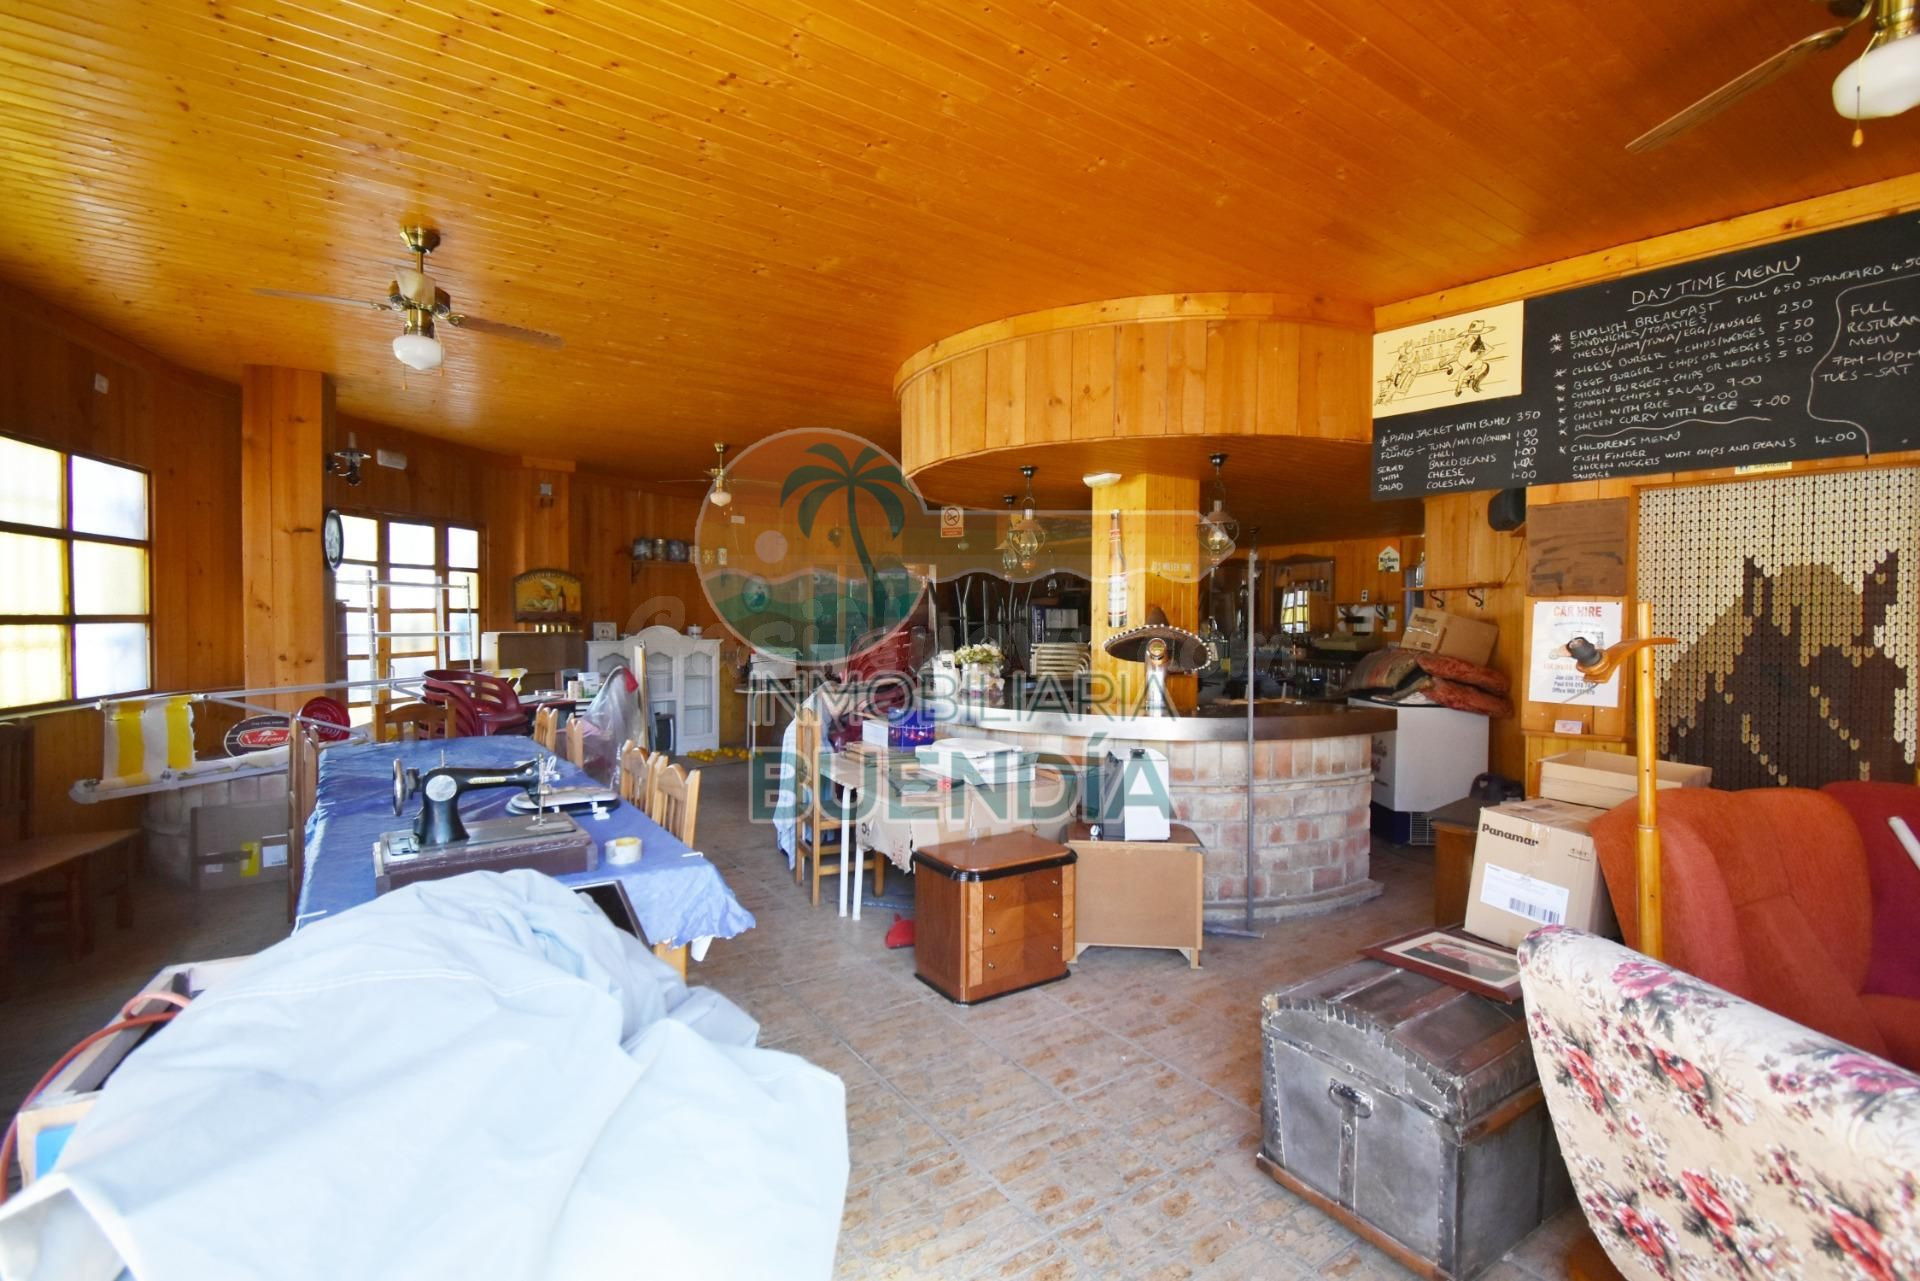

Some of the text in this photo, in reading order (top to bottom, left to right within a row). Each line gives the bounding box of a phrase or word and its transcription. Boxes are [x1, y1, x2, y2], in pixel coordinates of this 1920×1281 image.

[1735, 255, 1801, 282] MENU
[1569, 321, 1627, 341] ENGLISH
[1635, 300, 1723, 328] BREAKFAST
[1737, 291, 1767, 304] FULL
[1807, 265, 1884, 286] STANDARD
[1850, 300, 1895, 317] FULL
[1848, 332, 1900, 346] MENU
[1572, 360, 1613, 376] CHEESE
[1610, 365, 1655, 381] BURGER
[1668, 357, 1698, 370] CHIPS
[1701, 351, 1720, 361] OR
[1819, 370, 1858, 382] TUES
[1874, 363, 1914, 378] SAT
[1615, 379, 1662, 393] BURGER
[1673, 369, 1704, 383] CHIPS
[1706, 362, 1723, 374] OR
[1620, 390, 1652, 402] CHIPS
[1667, 382, 1715, 396] SALAD
[1610, 404, 1641, 415] WITH
[1643, 399, 1672, 410] RICE
[1619, 412, 1659, 424] CURRY
[1662, 407, 1698, 419] WITH
[1702, 401, 1738, 414] RICE
[1416, 424, 1453, 438] JACKET
[1456, 421, 1478, 432] WITH
[1570, 431, 1681, 453] CHILDRENS MENU
[1728, 443, 1750, 453] AND
[1459, 453, 1497, 466] BEANS
[1573, 449, 1647, 462] FISH FINGER
[1427, 467, 1465, 479] CHEESE
[1426, 476, 1475, 490] COLESLAW
[1576, 605, 1602, 617] HIRE
[1481, 822, 1539, 847] Panamar
